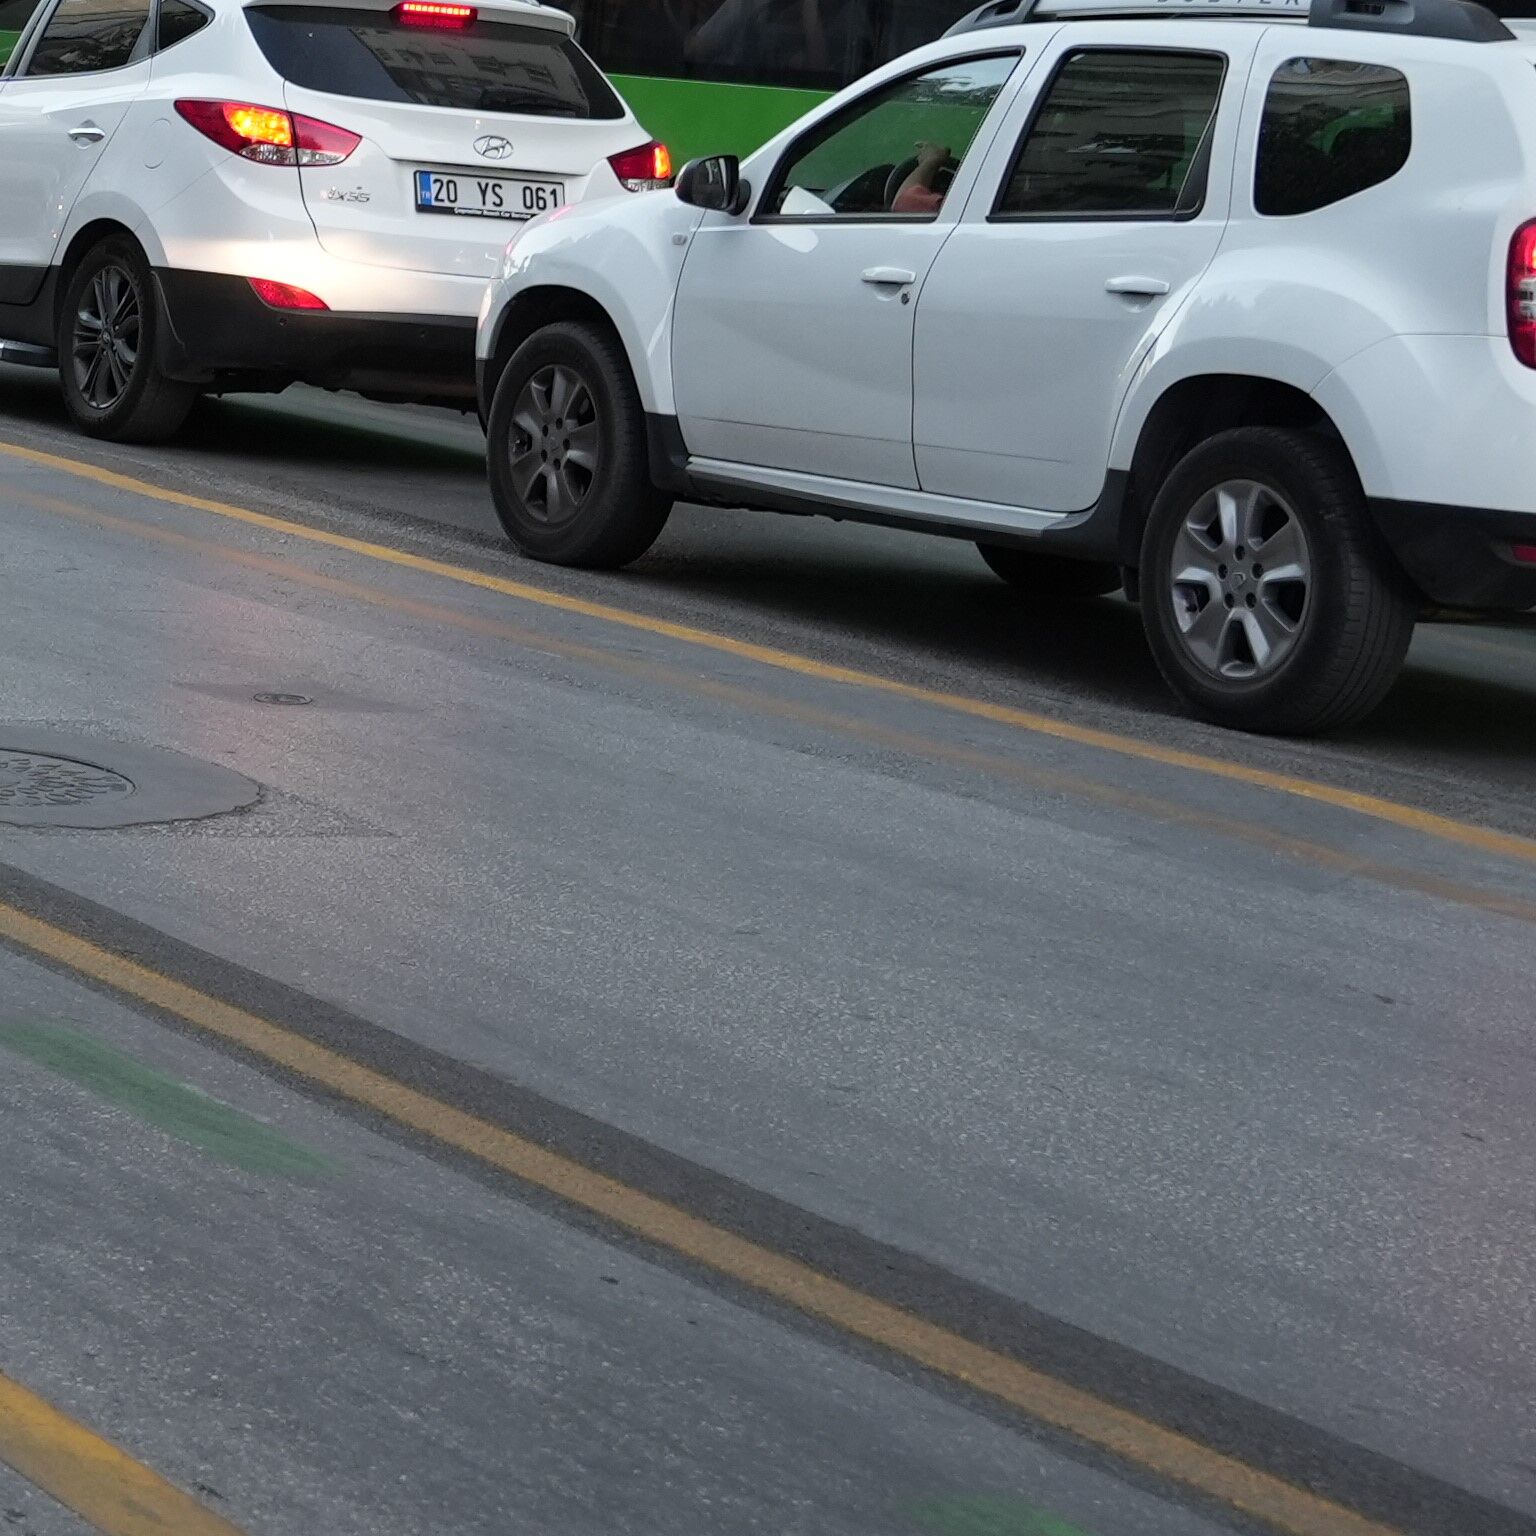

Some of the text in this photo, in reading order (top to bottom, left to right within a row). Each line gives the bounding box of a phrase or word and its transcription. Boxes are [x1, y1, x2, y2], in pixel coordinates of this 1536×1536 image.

[432, 178, 559, 211] 20 YS 061
